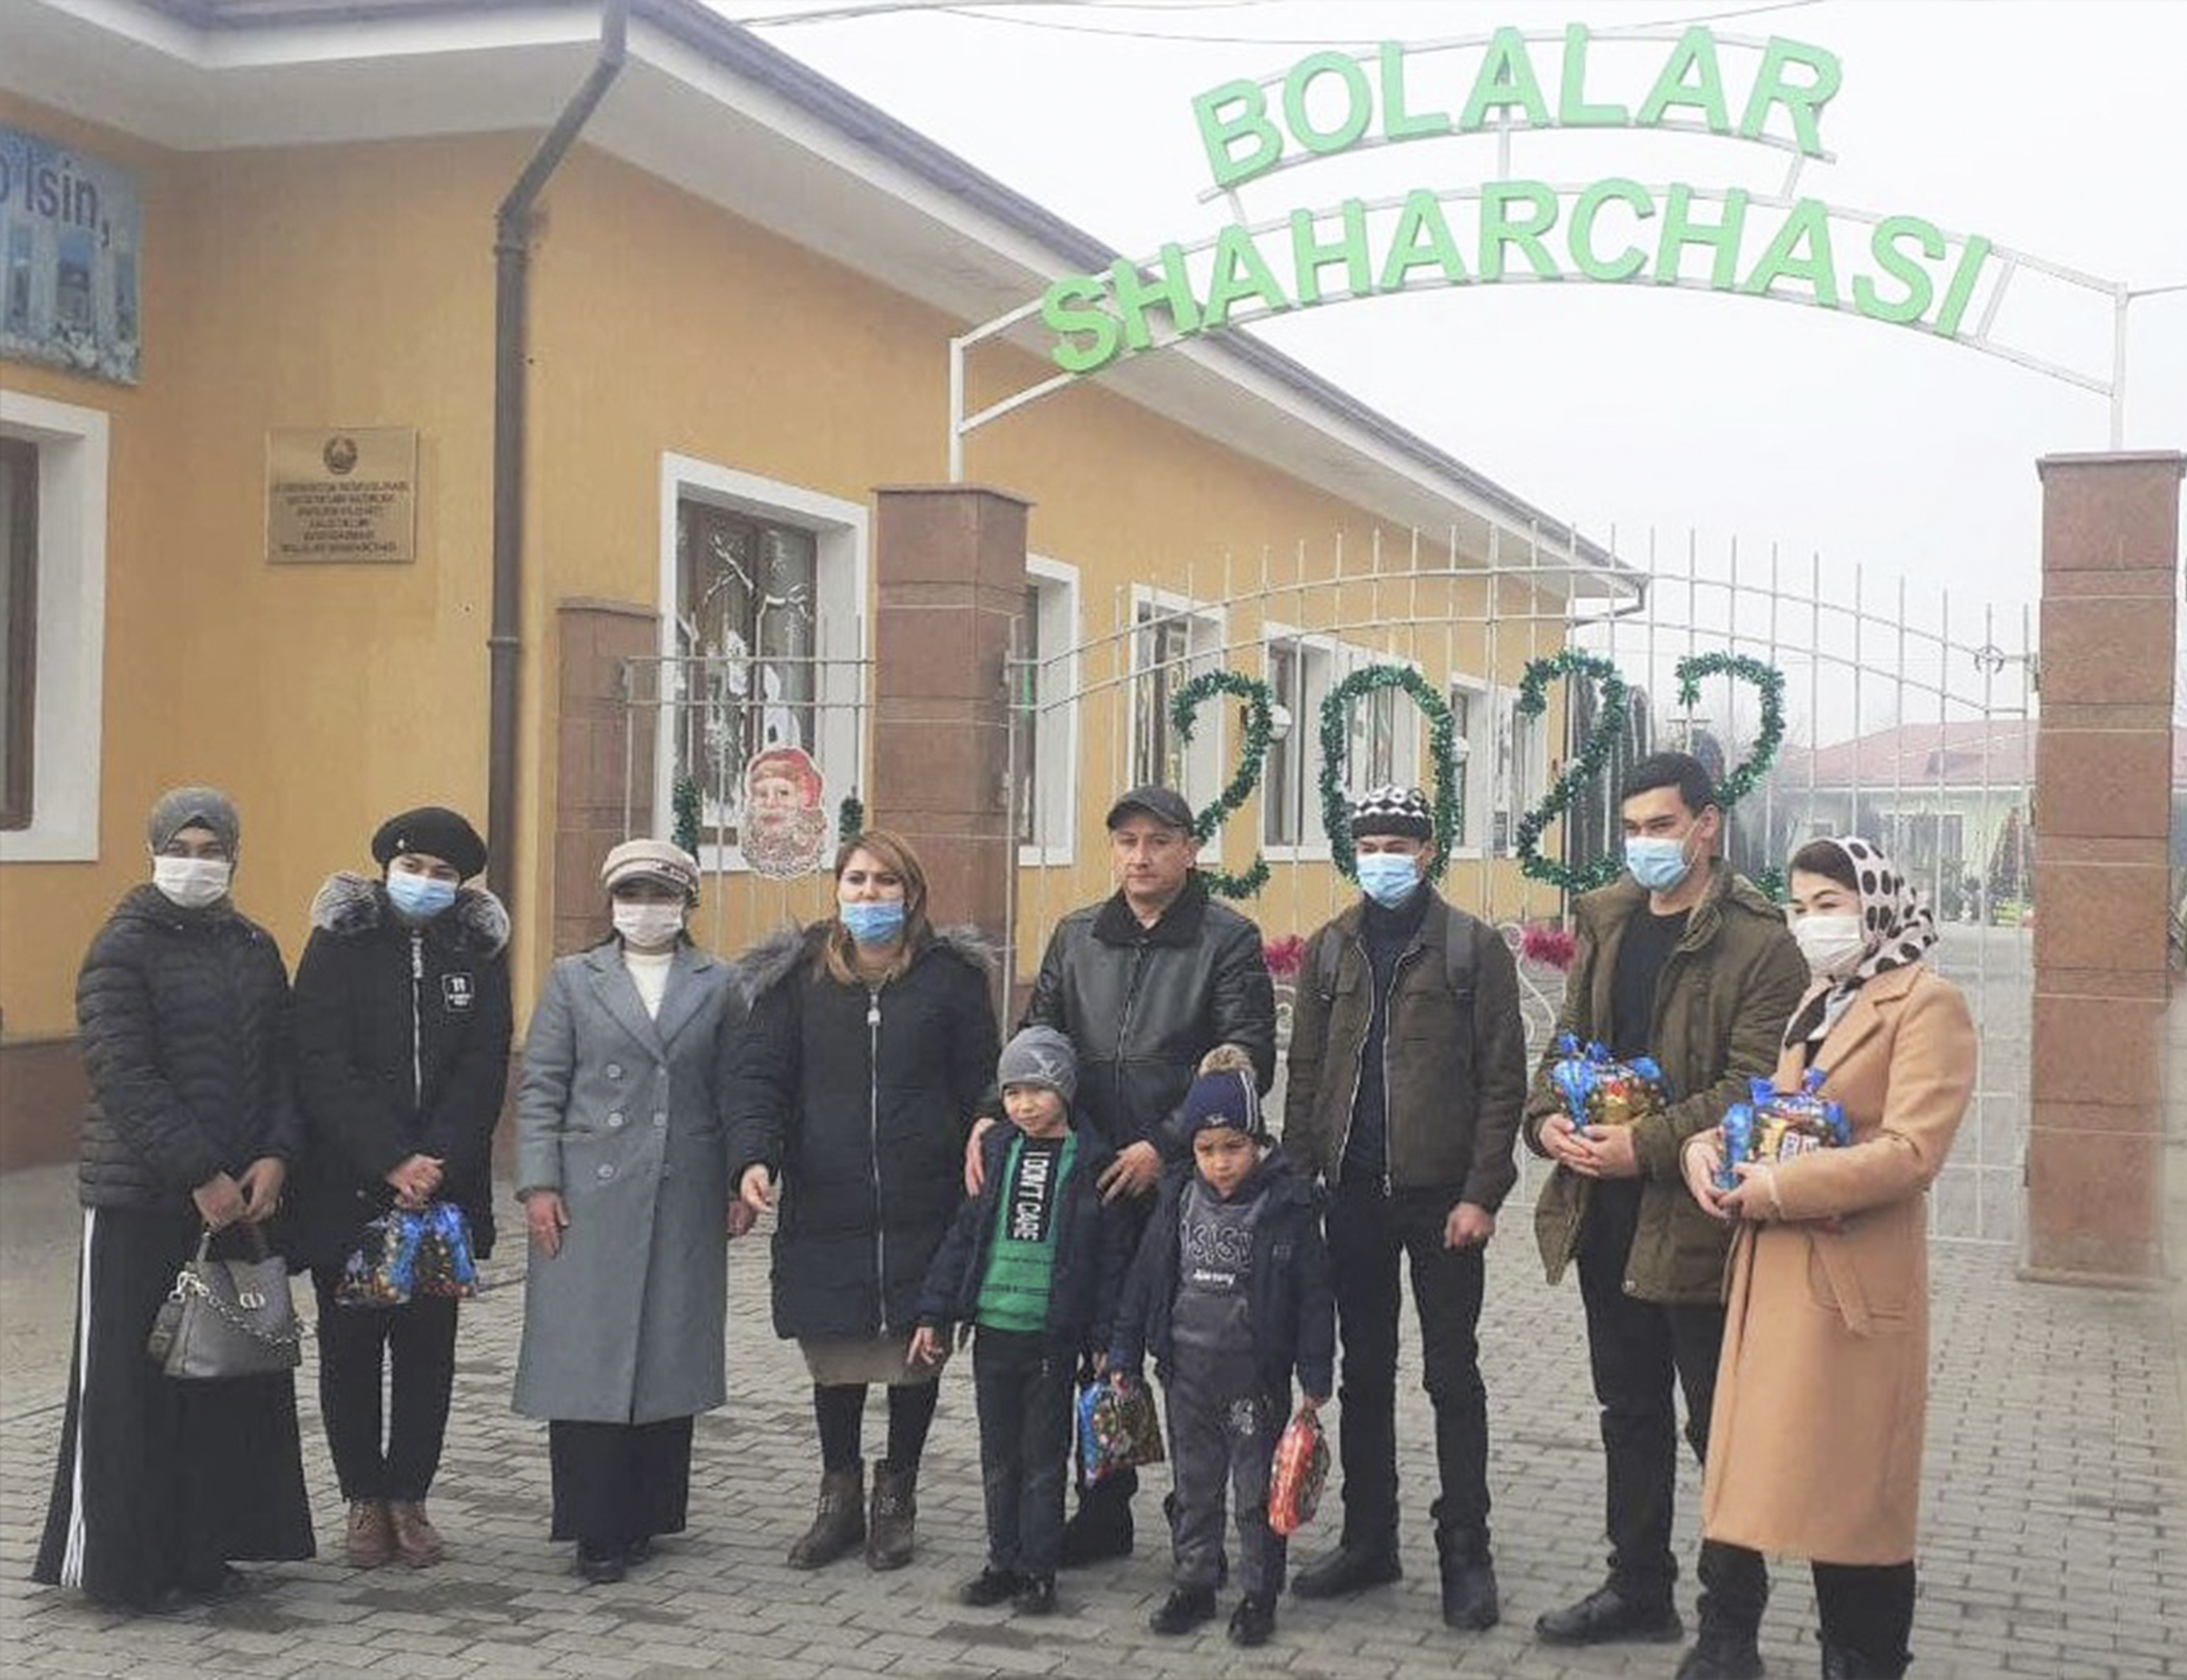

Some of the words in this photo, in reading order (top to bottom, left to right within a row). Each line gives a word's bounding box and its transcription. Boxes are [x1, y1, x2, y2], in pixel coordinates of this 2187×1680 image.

[1190, 22, 1843, 188] BOLALAR
[1040, 177, 1993, 373] SHAHARCHASI
[1013, 1202, 1041, 1241] CARE
